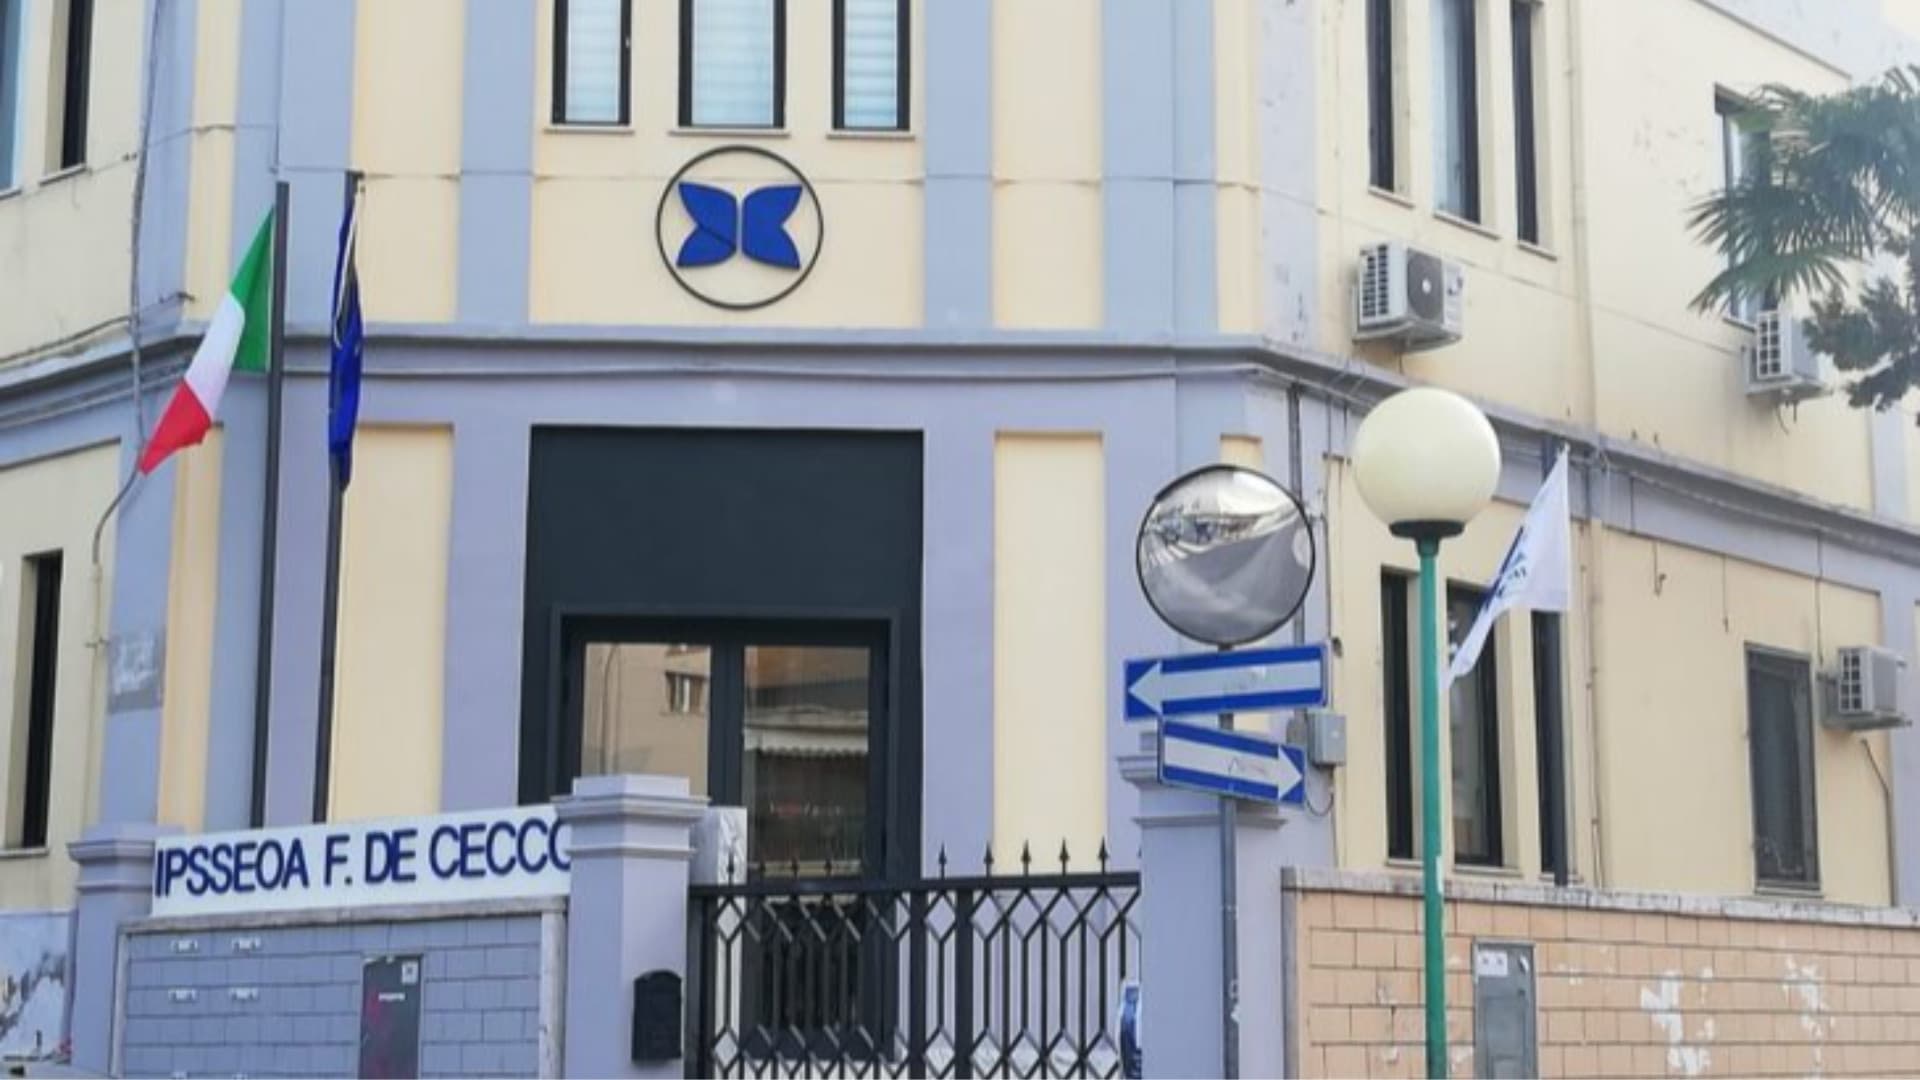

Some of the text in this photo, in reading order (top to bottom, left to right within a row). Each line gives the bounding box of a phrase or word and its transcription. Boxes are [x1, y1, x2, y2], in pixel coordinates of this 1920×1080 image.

[155, 837, 310, 898] IPSSEOA
[324, 834, 353, 886] F.
[364, 828, 418, 884] DE
